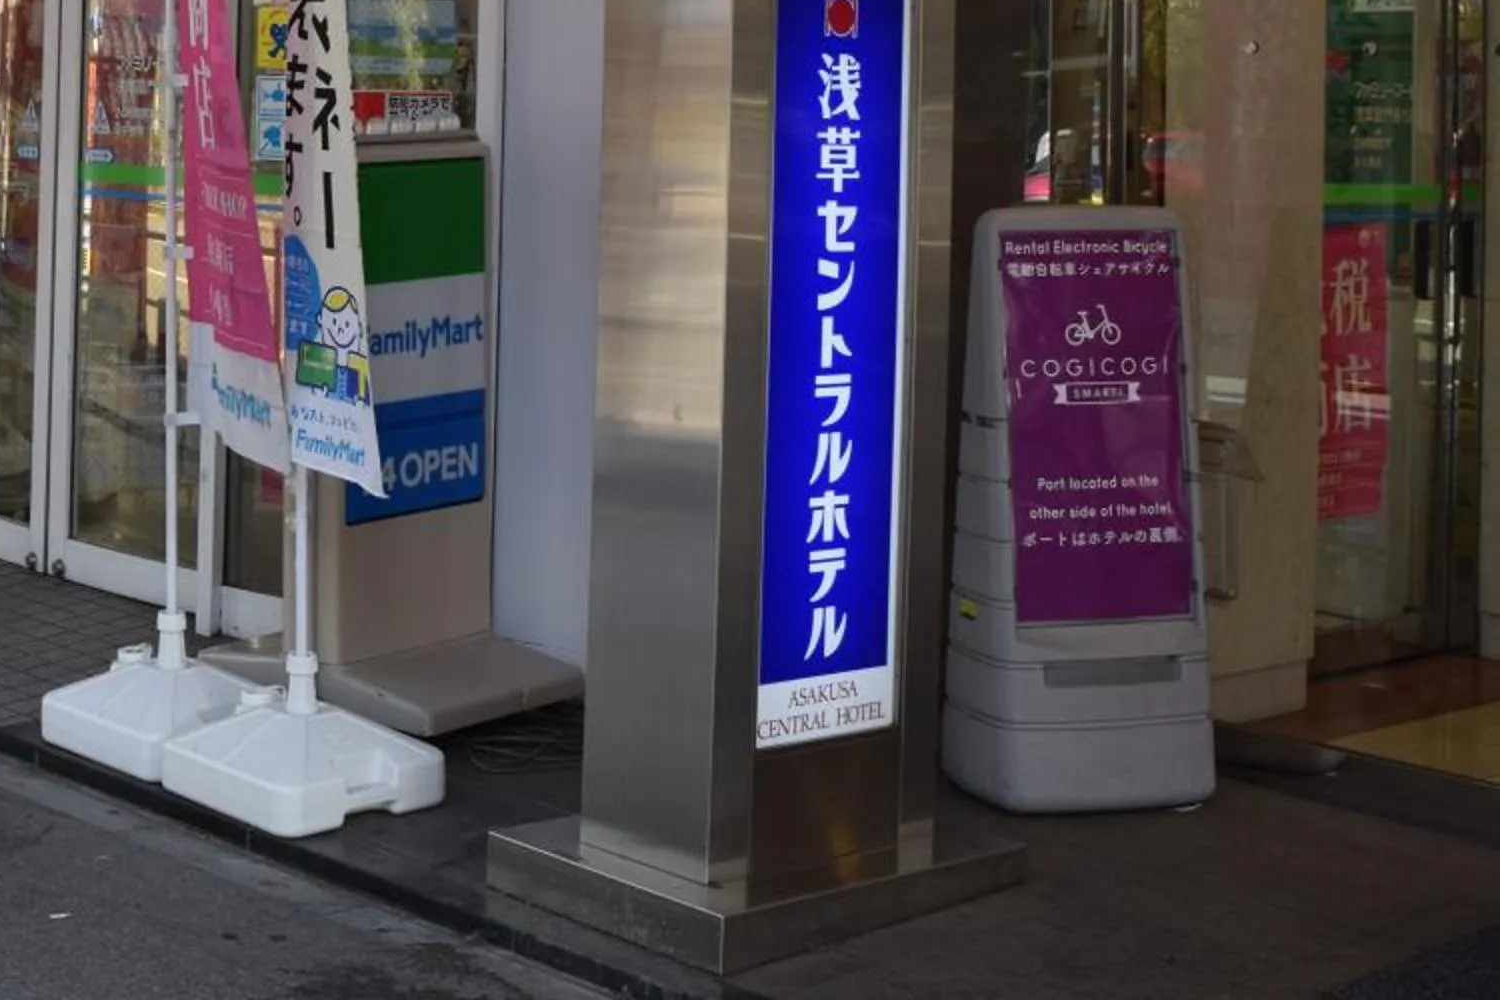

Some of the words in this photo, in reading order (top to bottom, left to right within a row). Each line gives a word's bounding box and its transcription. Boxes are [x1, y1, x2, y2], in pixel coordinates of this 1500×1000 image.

[1005, 241, 1049, 255] Rental
[1053, 240, 1119, 255] Electronic
[1123, 239, 1167, 256] Bicycle
[369, 313, 484, 358] amilyMart
[805, 53, 862, 663] 浅草セントラルホテル
[1021, 353, 1168, 378] COGICOGI
[401, 443, 479, 488] OPEN
[1036, 477, 1065, 491] Port
[1069, 475, 1117, 490] located
[1121, 477, 1137, 489] on
[1139, 474, 1159, 488] the
[1029, 505, 1065, 520] other
[1069, 505, 1097, 519] side
[1100, 504, 1113, 518] of
[1115, 503, 1137, 517] the
[788, 680, 859, 709] ASAKUSA
[757, 711, 830, 740] CENTRAL
[836, 701, 885, 727] HOTEL
